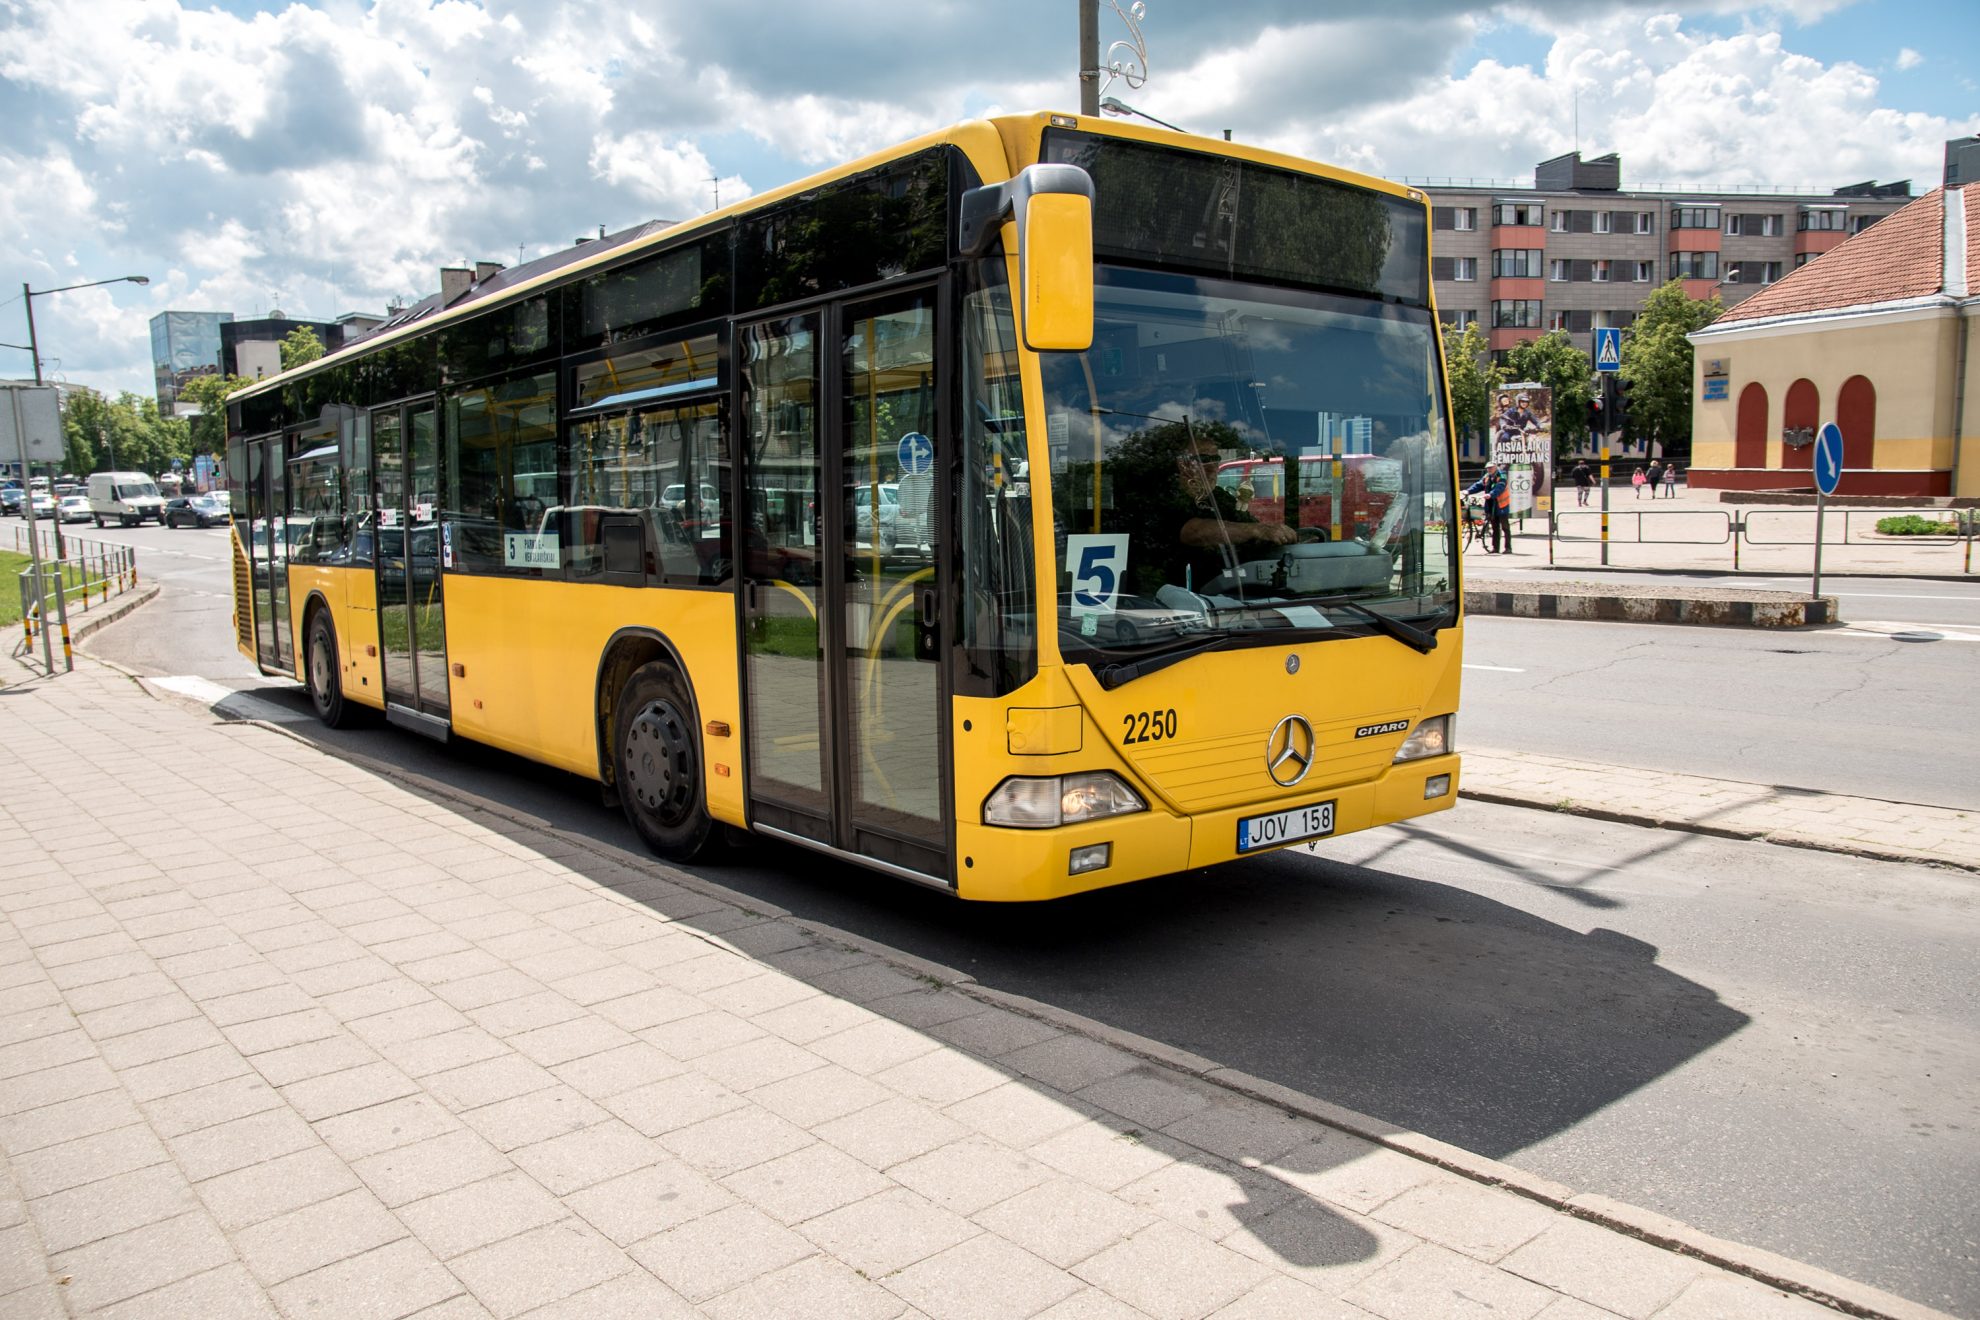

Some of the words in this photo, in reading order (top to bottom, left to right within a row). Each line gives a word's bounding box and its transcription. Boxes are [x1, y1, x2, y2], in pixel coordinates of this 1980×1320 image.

[1492, 440, 1550, 453] LAISVALAIKIO
[510, 537, 516, 560] 5
[1074, 545, 1116, 606] 5
[1123, 708, 1177, 744] 2250
[1357, 721, 1408, 736] CITARO
[1251, 814, 1288, 843] JOV
[1302, 807, 1330, 833] 158
